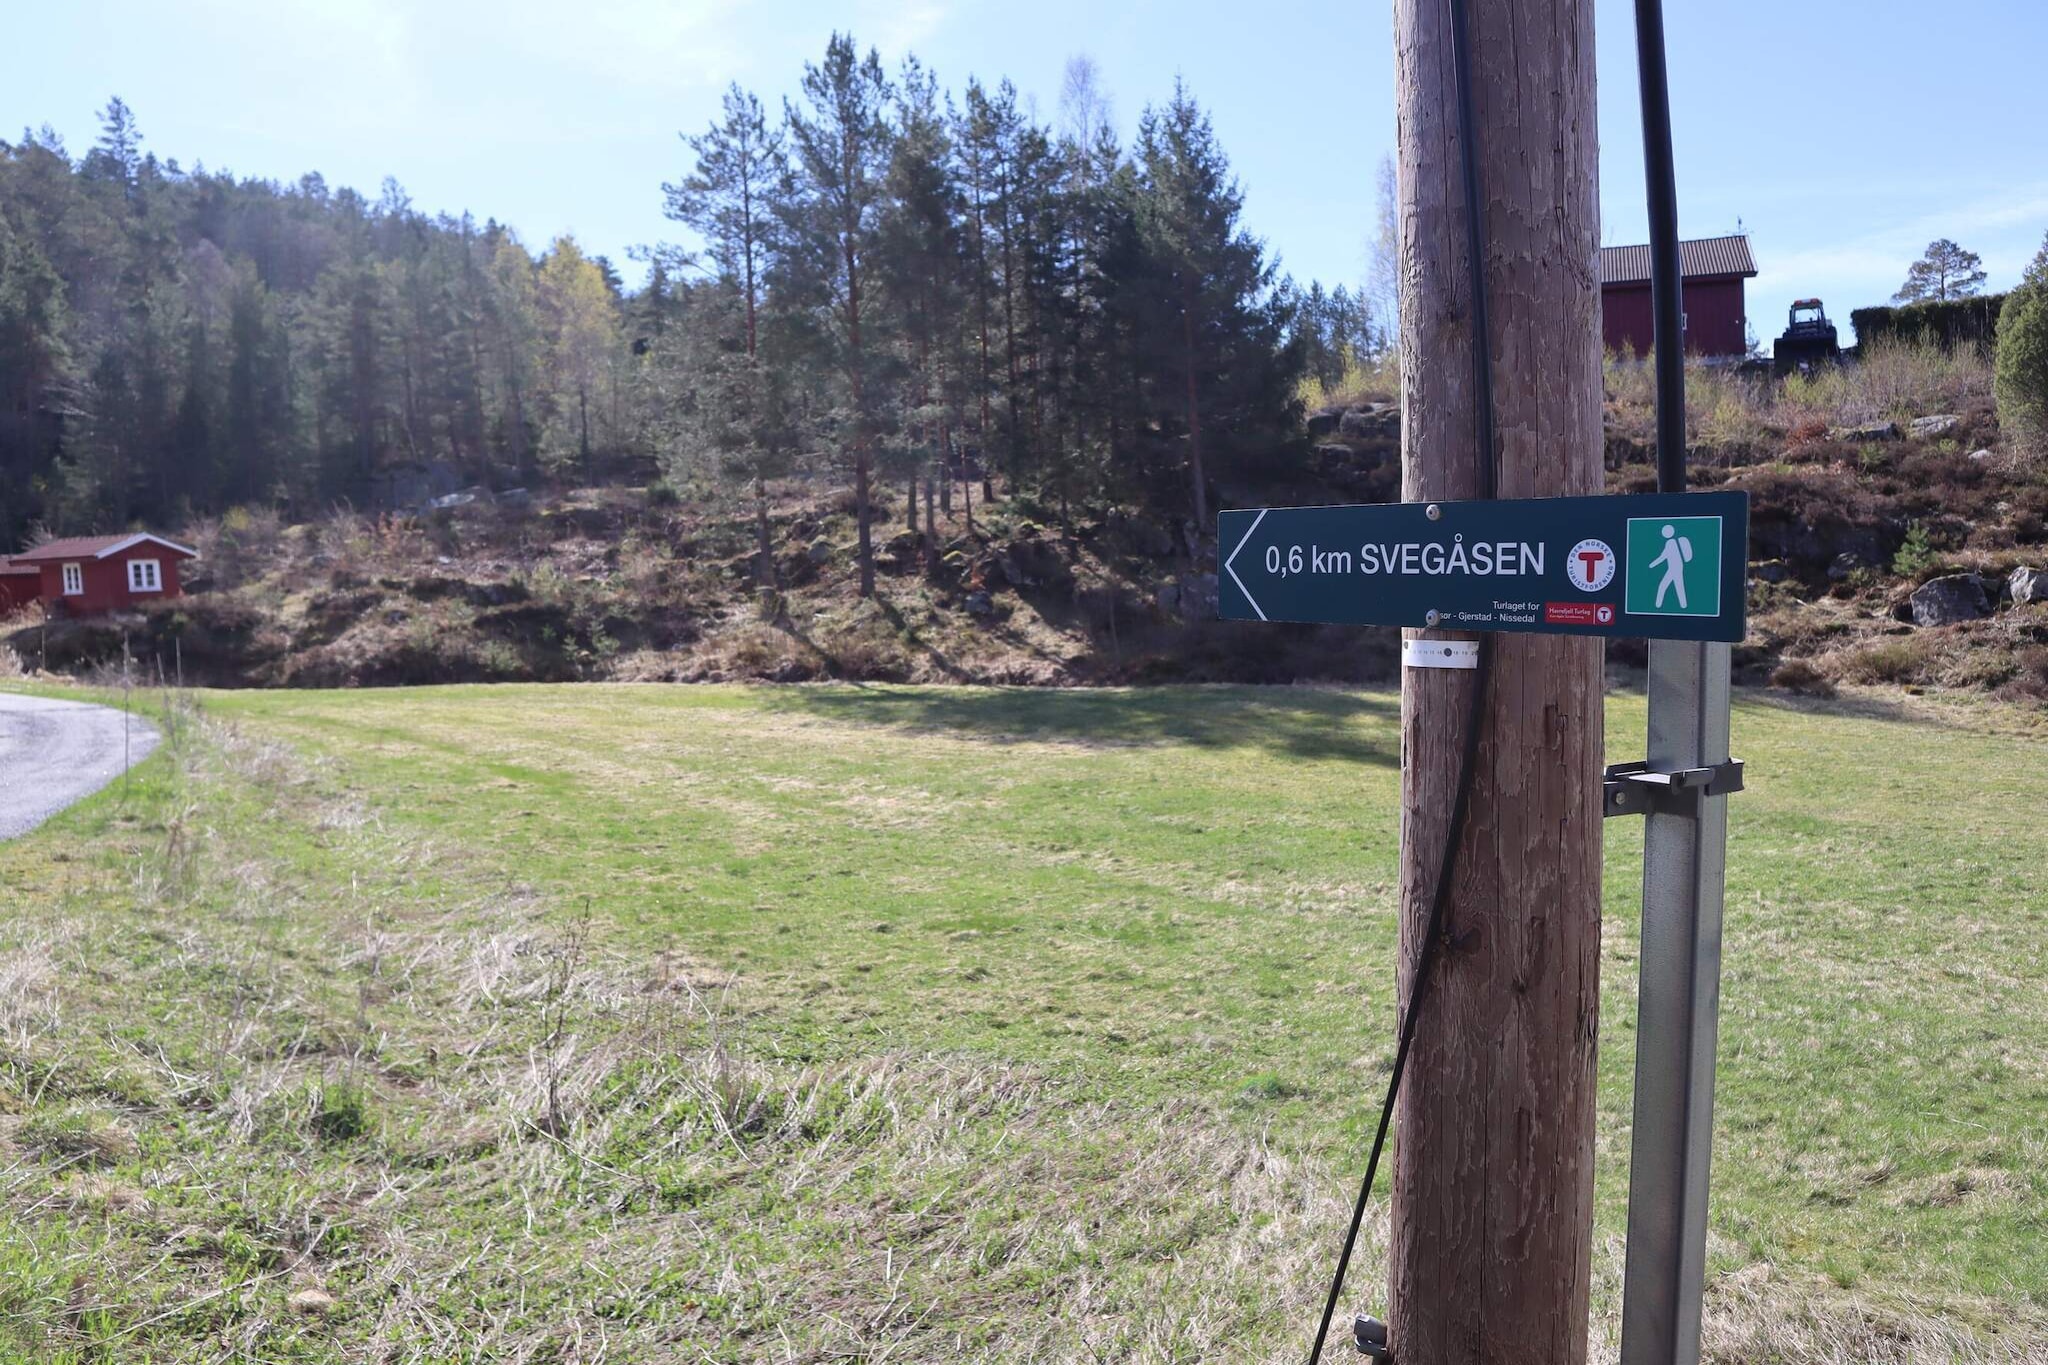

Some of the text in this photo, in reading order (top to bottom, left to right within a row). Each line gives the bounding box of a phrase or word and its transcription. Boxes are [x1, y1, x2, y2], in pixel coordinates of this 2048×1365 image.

[1265, 533, 1545, 578] 0,6 km SVEGÅSEN
[1578, 552, 1604, 583] T
[1492, 600, 1540, 611] Turlaget for
[1458, 612, 1492, 622] Gjerstad
[1499, 613, 1536, 623] Nissedal
